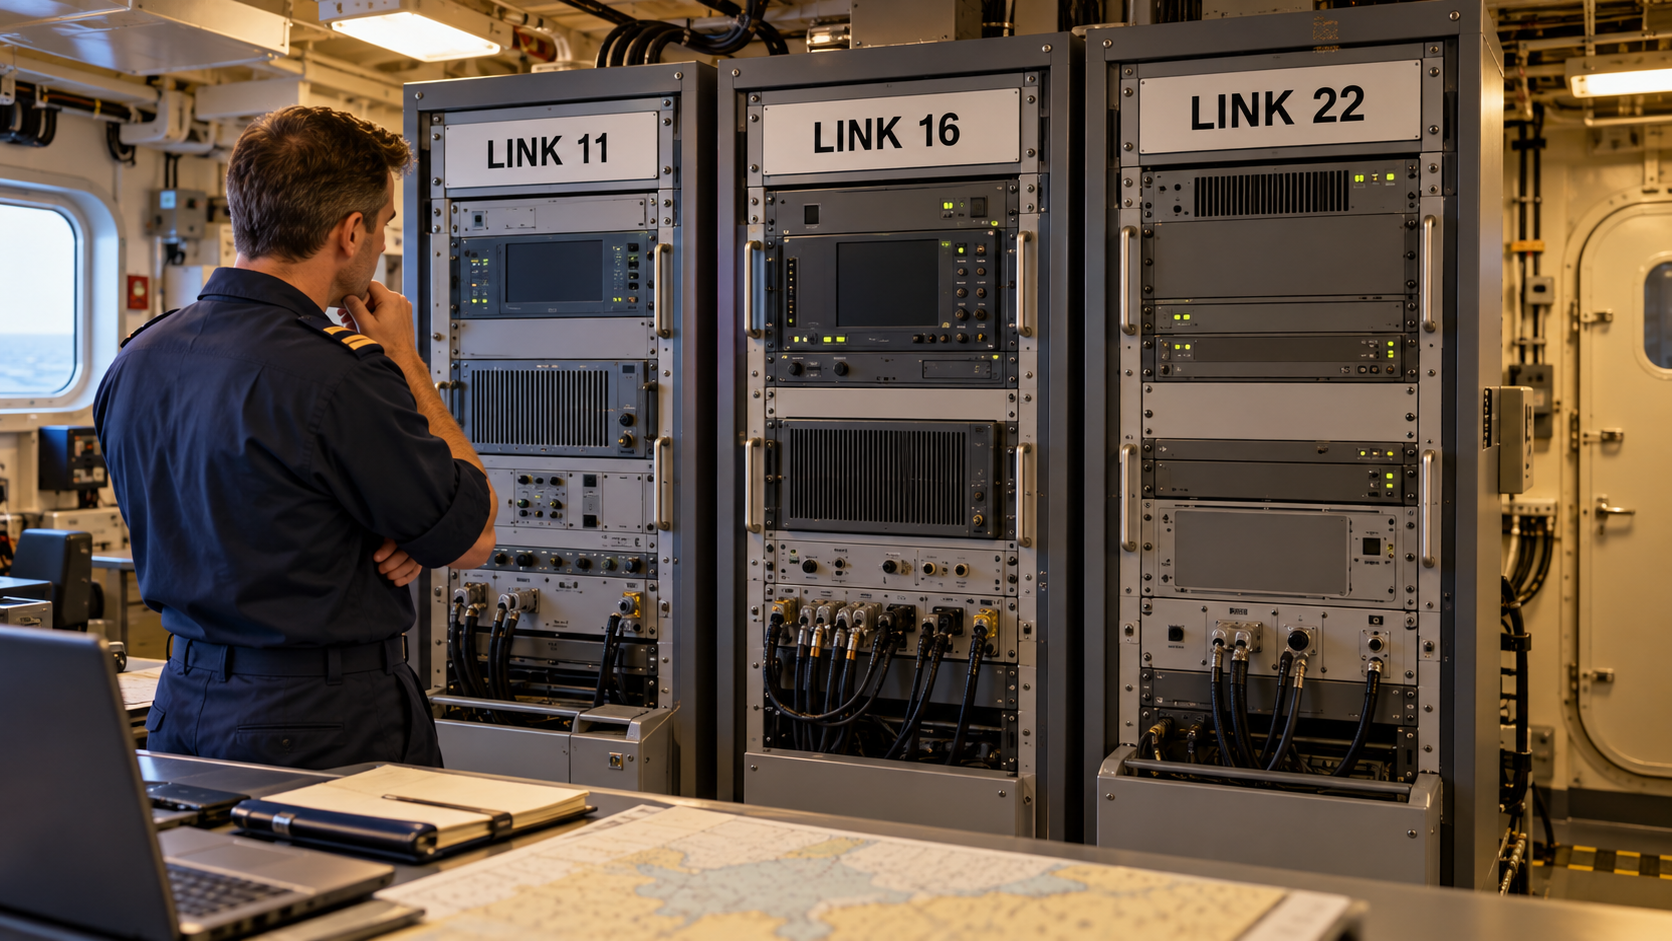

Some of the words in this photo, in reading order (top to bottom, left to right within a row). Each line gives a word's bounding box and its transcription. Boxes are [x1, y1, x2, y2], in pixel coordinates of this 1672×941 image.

[1191, 89, 1295, 131] LINK
[1312, 84, 1366, 124] 22
[486, 135, 563, 169] LINK
[577, 132, 608, 164] 11
[813, 115, 903, 154] LINK
[919, 112, 961, 147] 16
